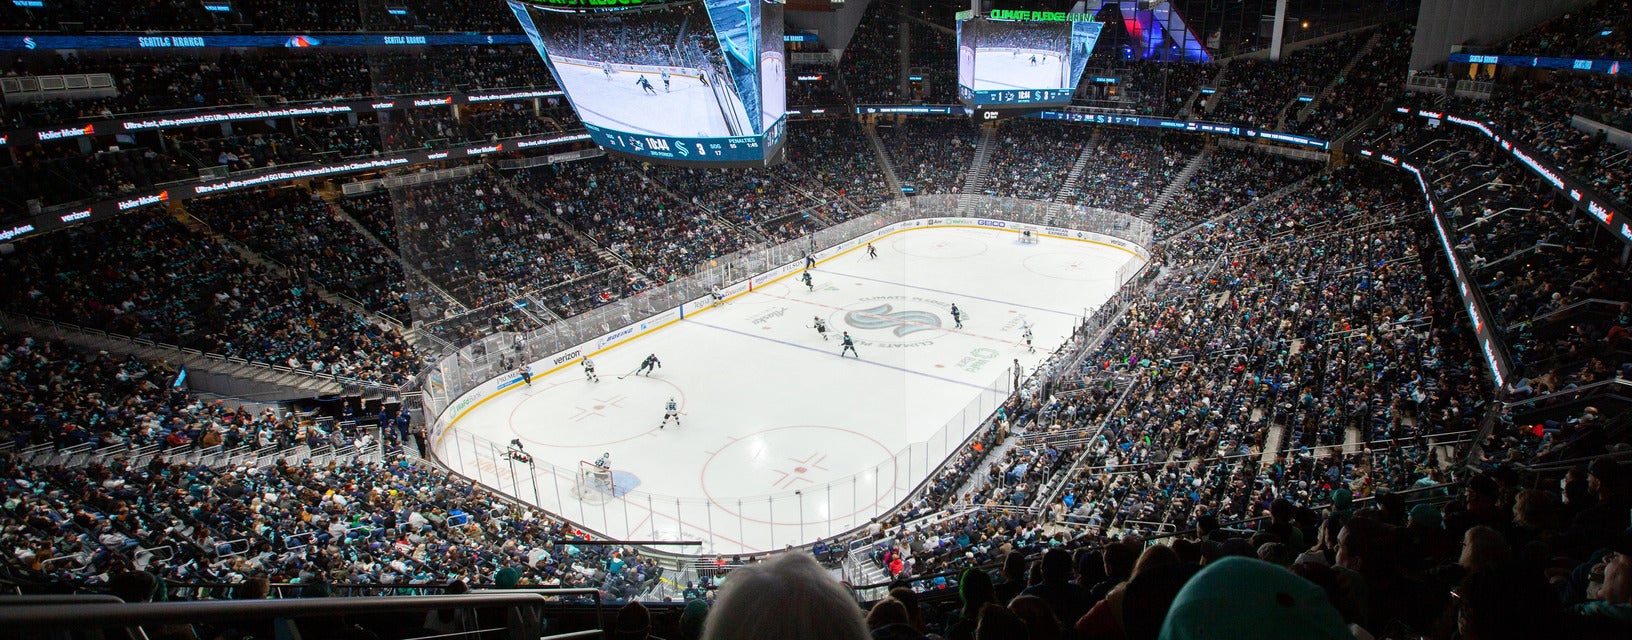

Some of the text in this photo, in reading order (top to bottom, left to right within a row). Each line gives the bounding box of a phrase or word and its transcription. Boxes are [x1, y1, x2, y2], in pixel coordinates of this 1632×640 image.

[990, 9, 1096, 22] CLIMATE PLEDGE ARENA
[138, 36, 205, 47] SEATTLE KRAKEN
[695, 143, 706, 156] 3
[61, 210, 90, 222] verizon
[977, 219, 1006, 228] GEICO
[606, 327, 634, 342] BOEING
[553, 349, 582, 366] verizon
